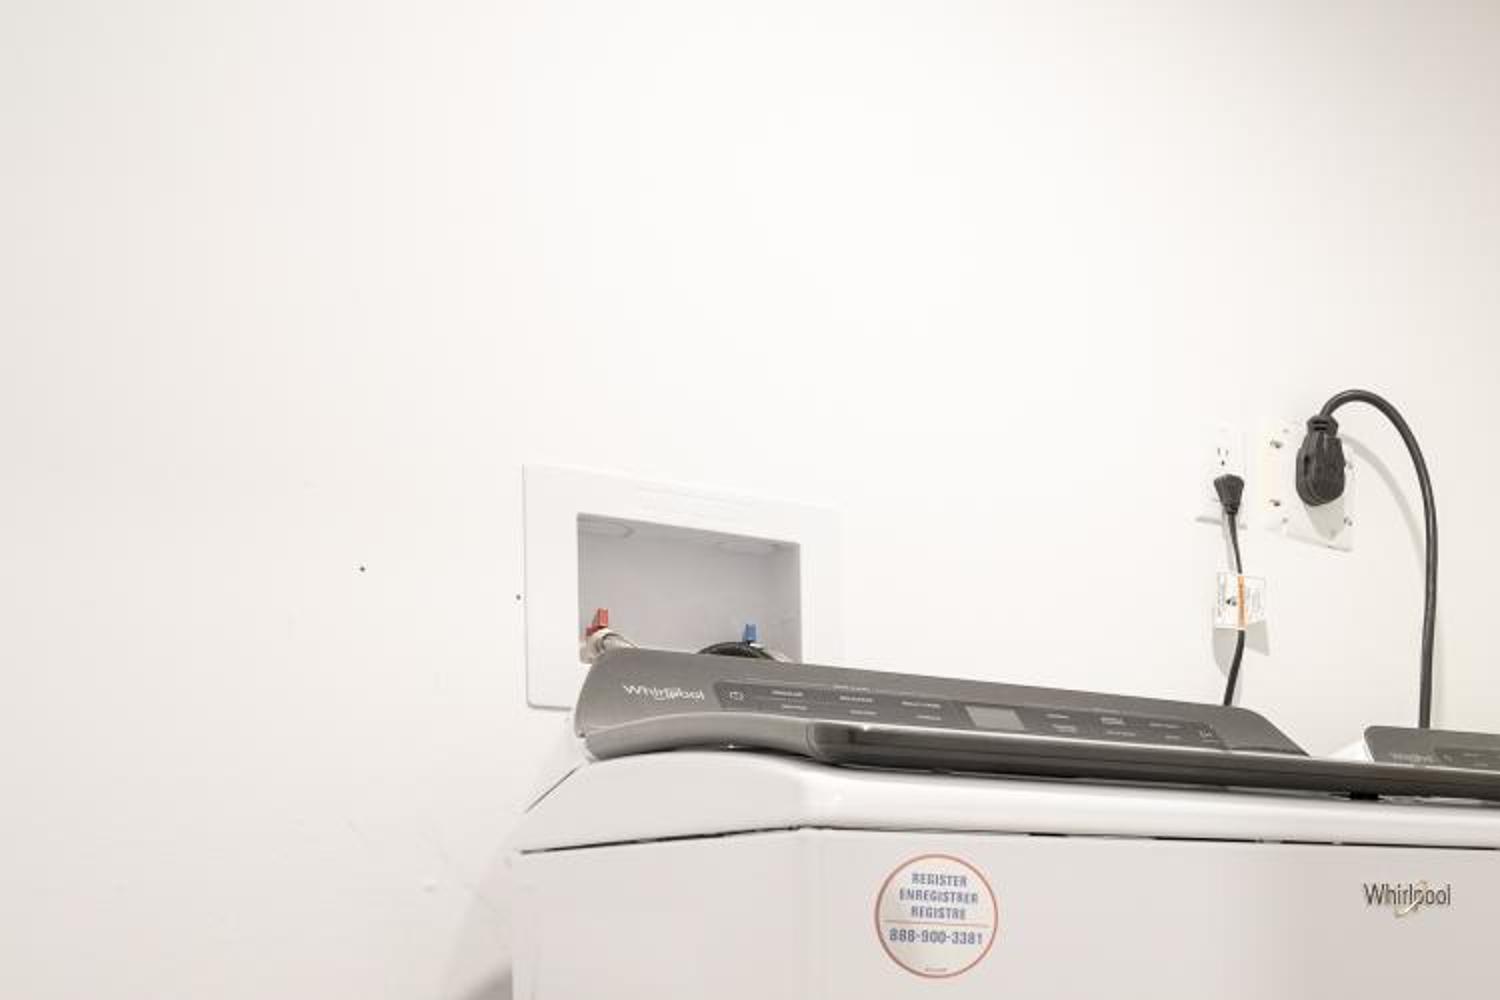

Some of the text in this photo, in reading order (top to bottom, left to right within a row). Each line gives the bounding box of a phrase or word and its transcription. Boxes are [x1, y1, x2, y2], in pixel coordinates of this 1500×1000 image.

[623, 684, 704, 701] Whirlpool
[911, 873, 967, 887] REGISTER
[899, 888, 978, 904] ENREGISTRER
[1363, 882, 1451, 910] Whirlpool
[911, 906, 966, 920] REGISTRE
[888, 928, 983, 945] 888-900-3381
